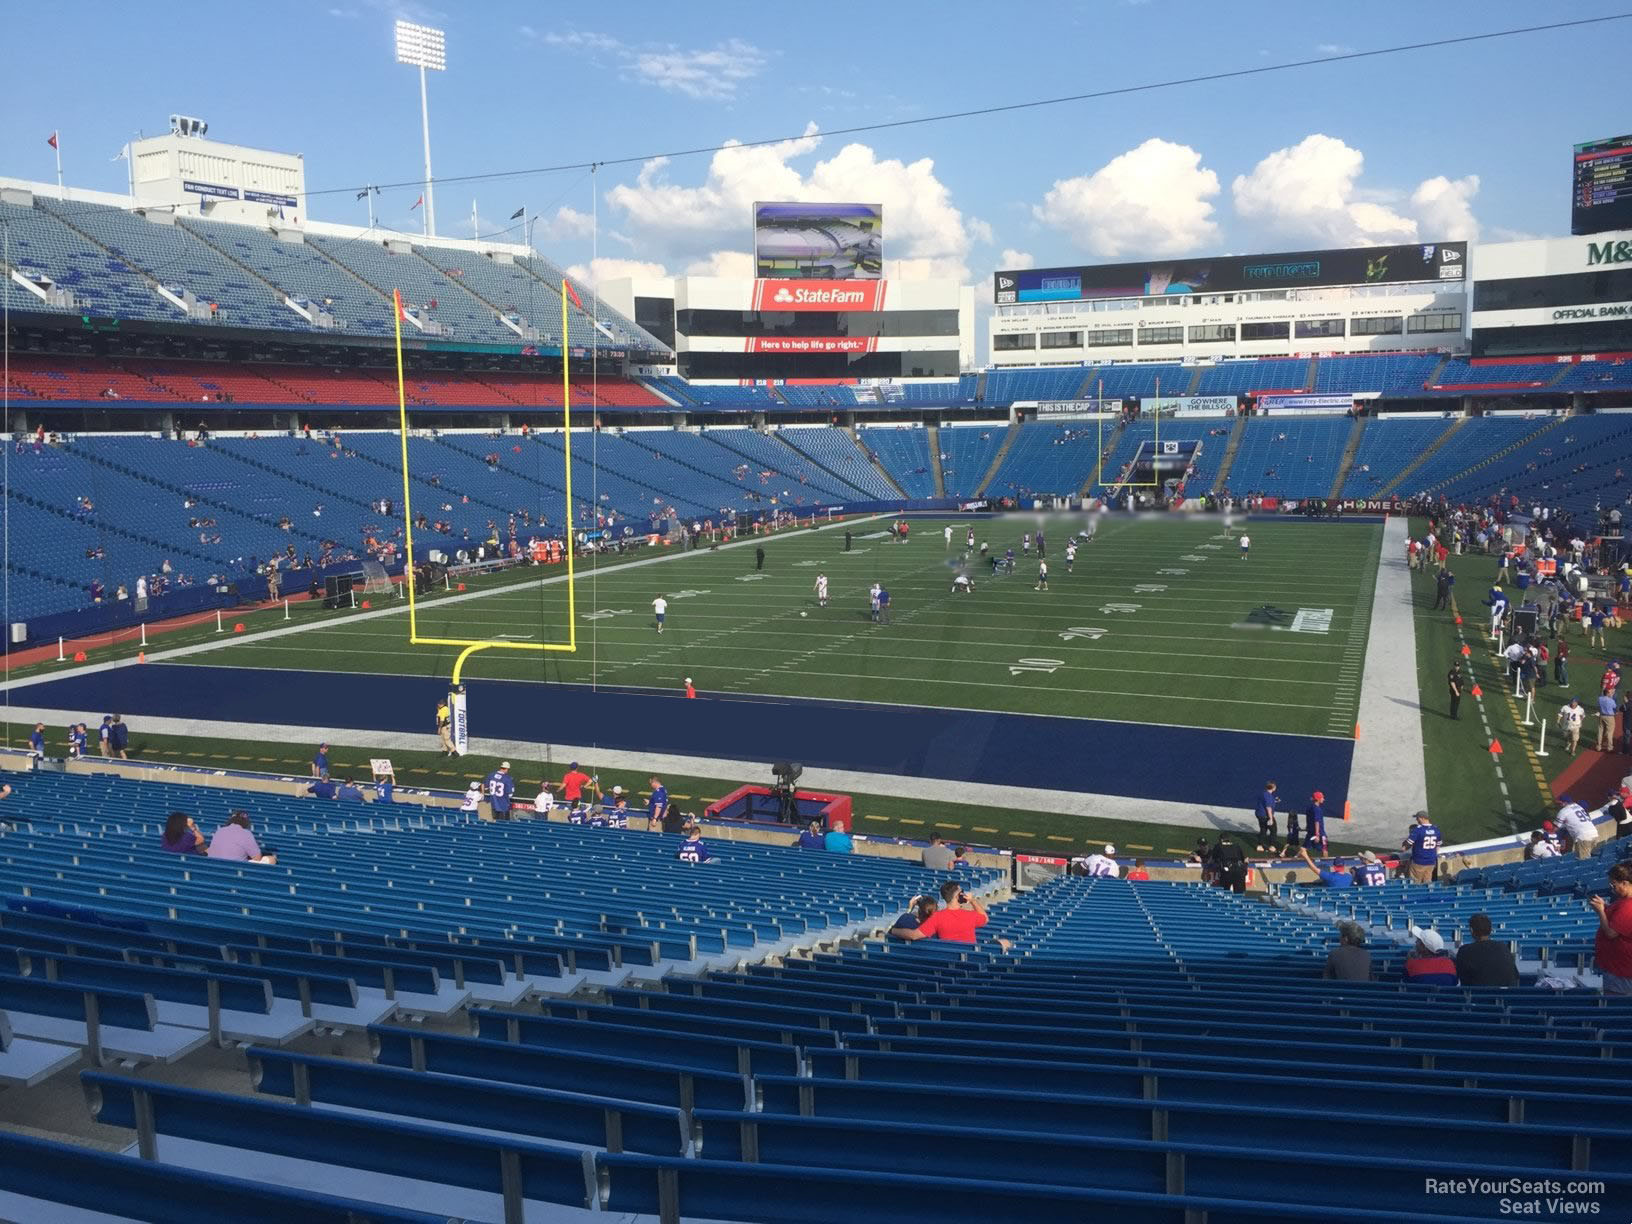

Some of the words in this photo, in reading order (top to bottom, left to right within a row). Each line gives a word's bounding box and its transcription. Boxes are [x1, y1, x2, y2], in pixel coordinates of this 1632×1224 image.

[1552, 308, 1597, 320] OFFICIAL
[1599, 305, 1628, 316] BANK
[761, 340, 780, 349] Here
[782, 341, 790, 349] to
[791, 340, 809, 350] help
[811, 340, 824, 349] life
[826, 342, 836, 350] go
[1038, 403, 1054, 411] THIS
[1061, 403, 1075, 411] THE
[1075, 402, 1090, 411] CAP
[1566, 713, 1576, 722] 14
[489, 780, 505, 797] 83
[1422, 836, 1437, 849] 25
[1365, 872, 1386, 887] 12
